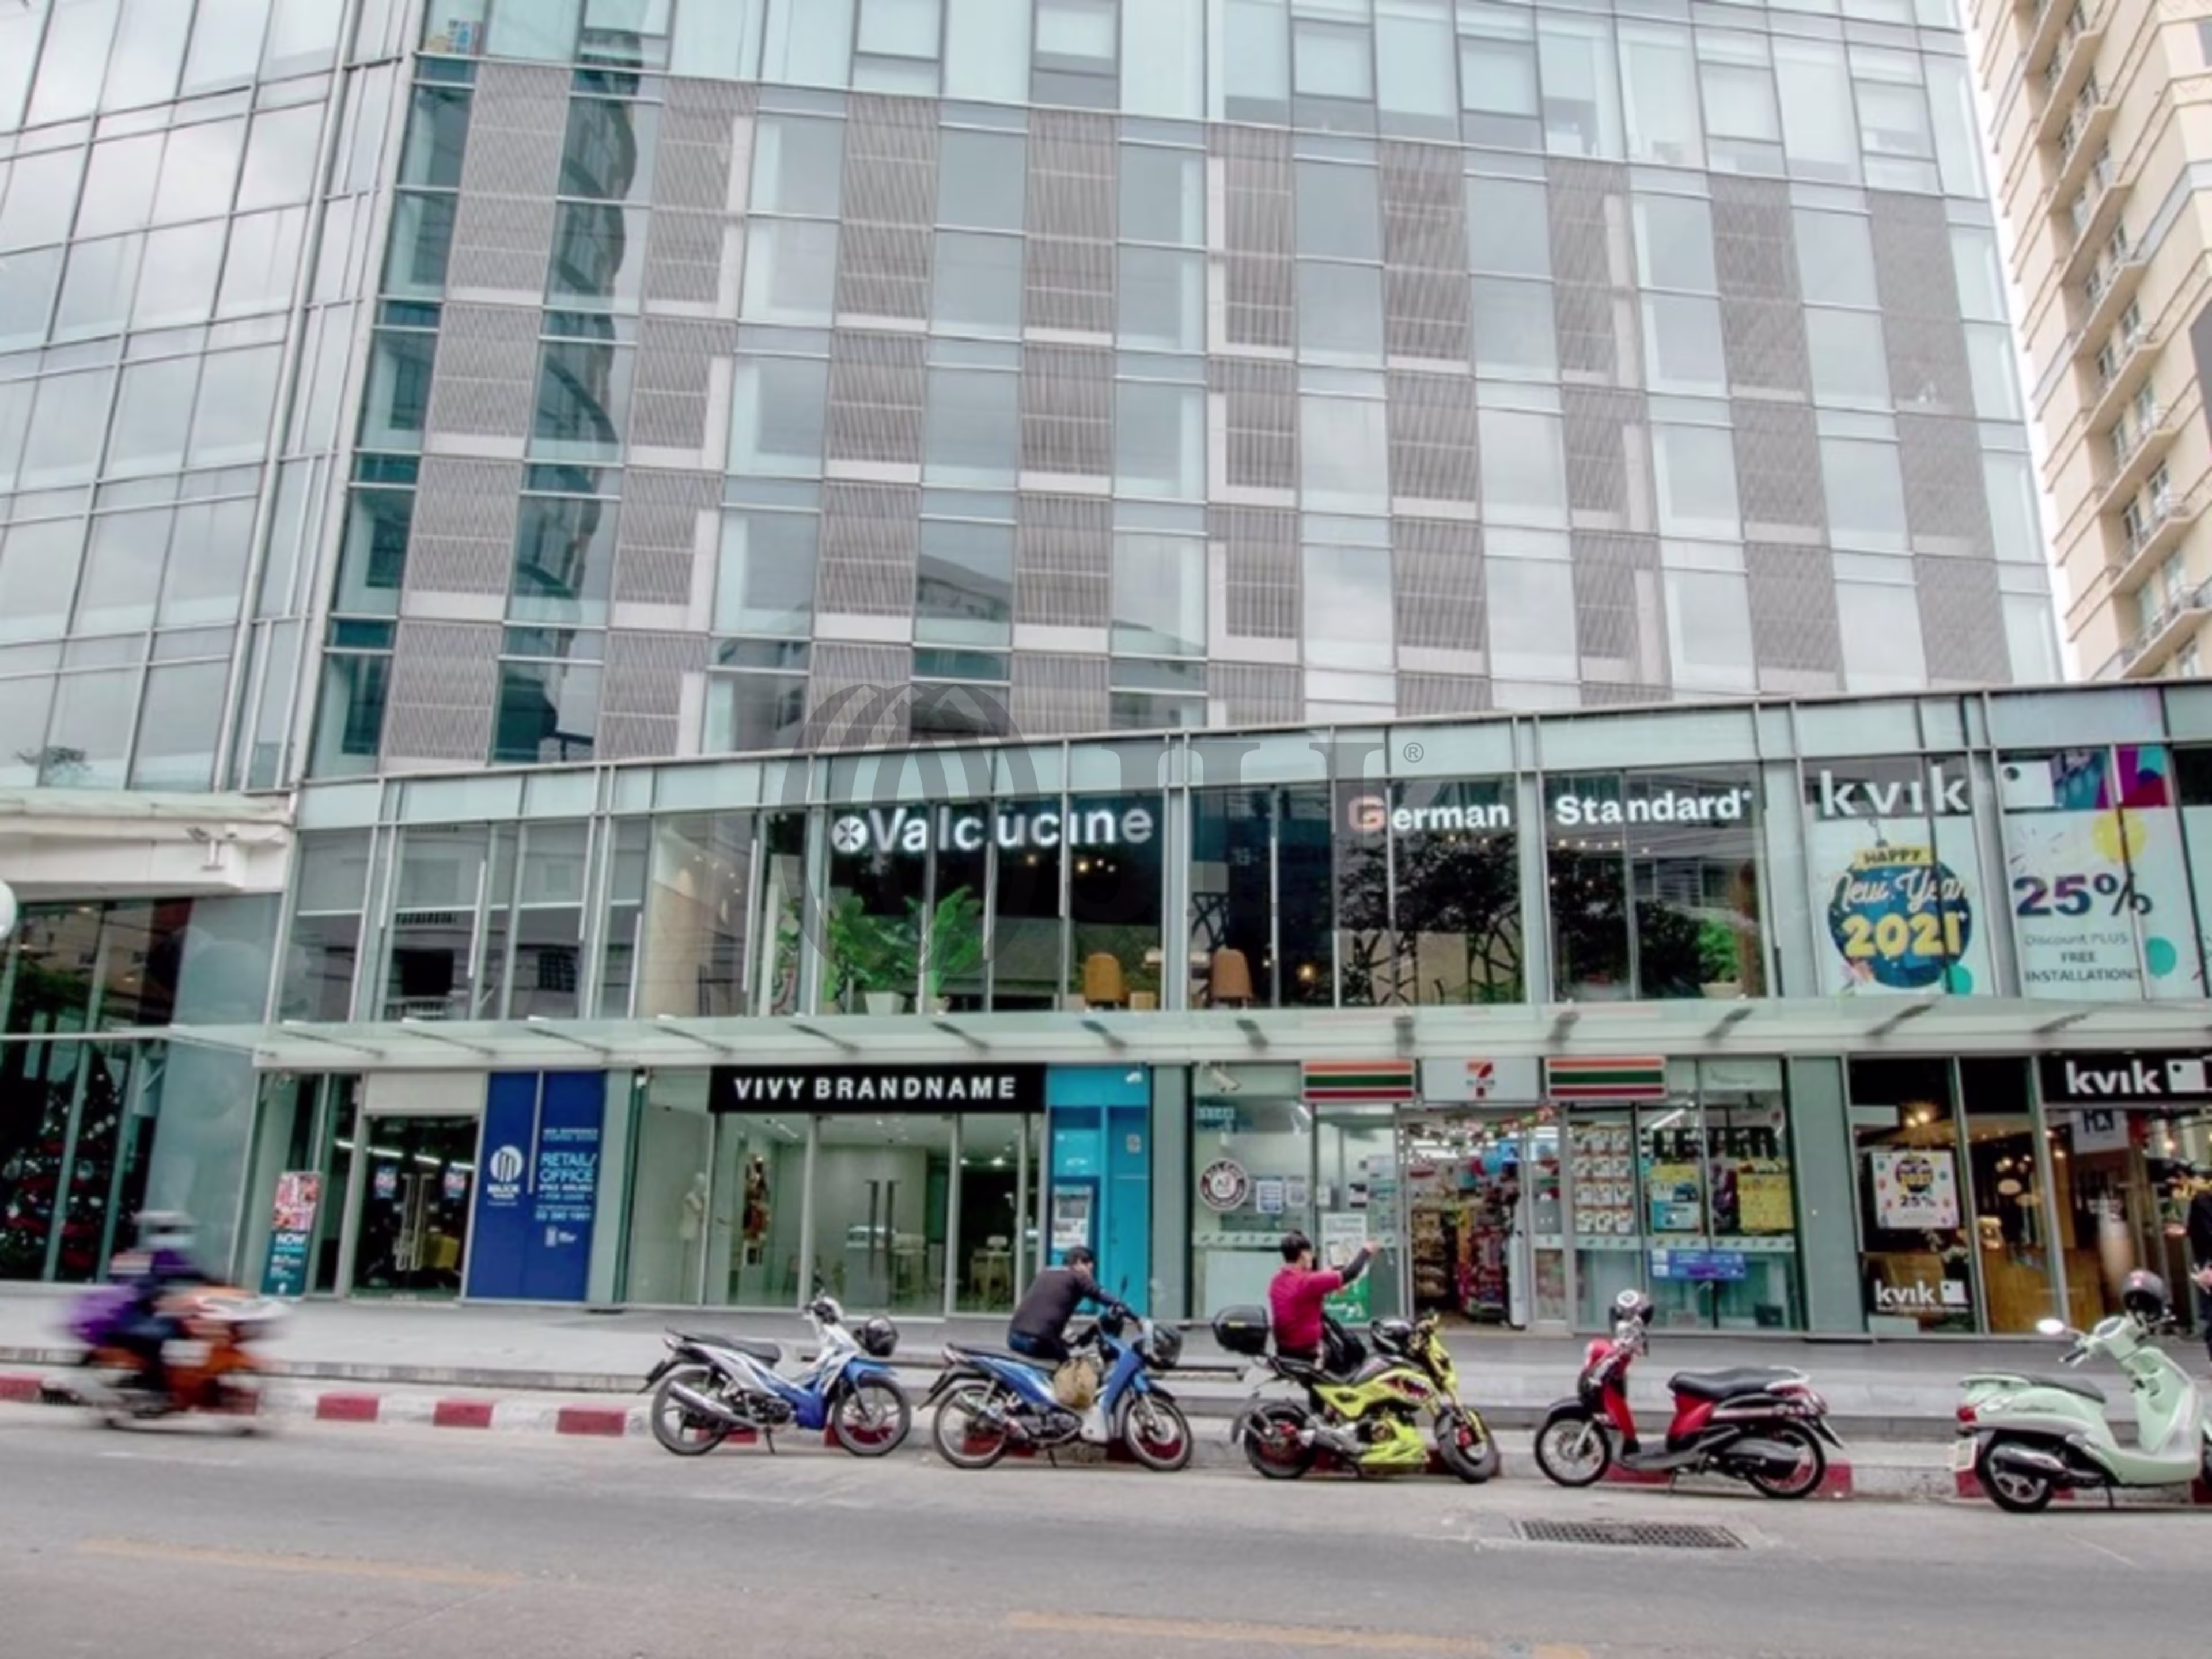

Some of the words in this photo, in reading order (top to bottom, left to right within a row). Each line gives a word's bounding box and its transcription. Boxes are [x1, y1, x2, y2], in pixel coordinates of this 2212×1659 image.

[1348, 794, 1511, 833] German
[868, 805, 1154, 853] Valcucine
[1863, 849, 1921, 863] HAPPY
[2013, 872, 2153, 917] 25%
[1842, 911, 1960, 957] 2021
[2061, 951, 2097, 963] FREE
[735, 1078, 804, 1099] VIVY
[813, 1076, 1016, 1100] BRANDNAME
[2065, 1060, 2162, 1094] kvik
[539, 1167, 593, 1184] OFFICE
[1874, 1279, 1937, 1305] kvik
